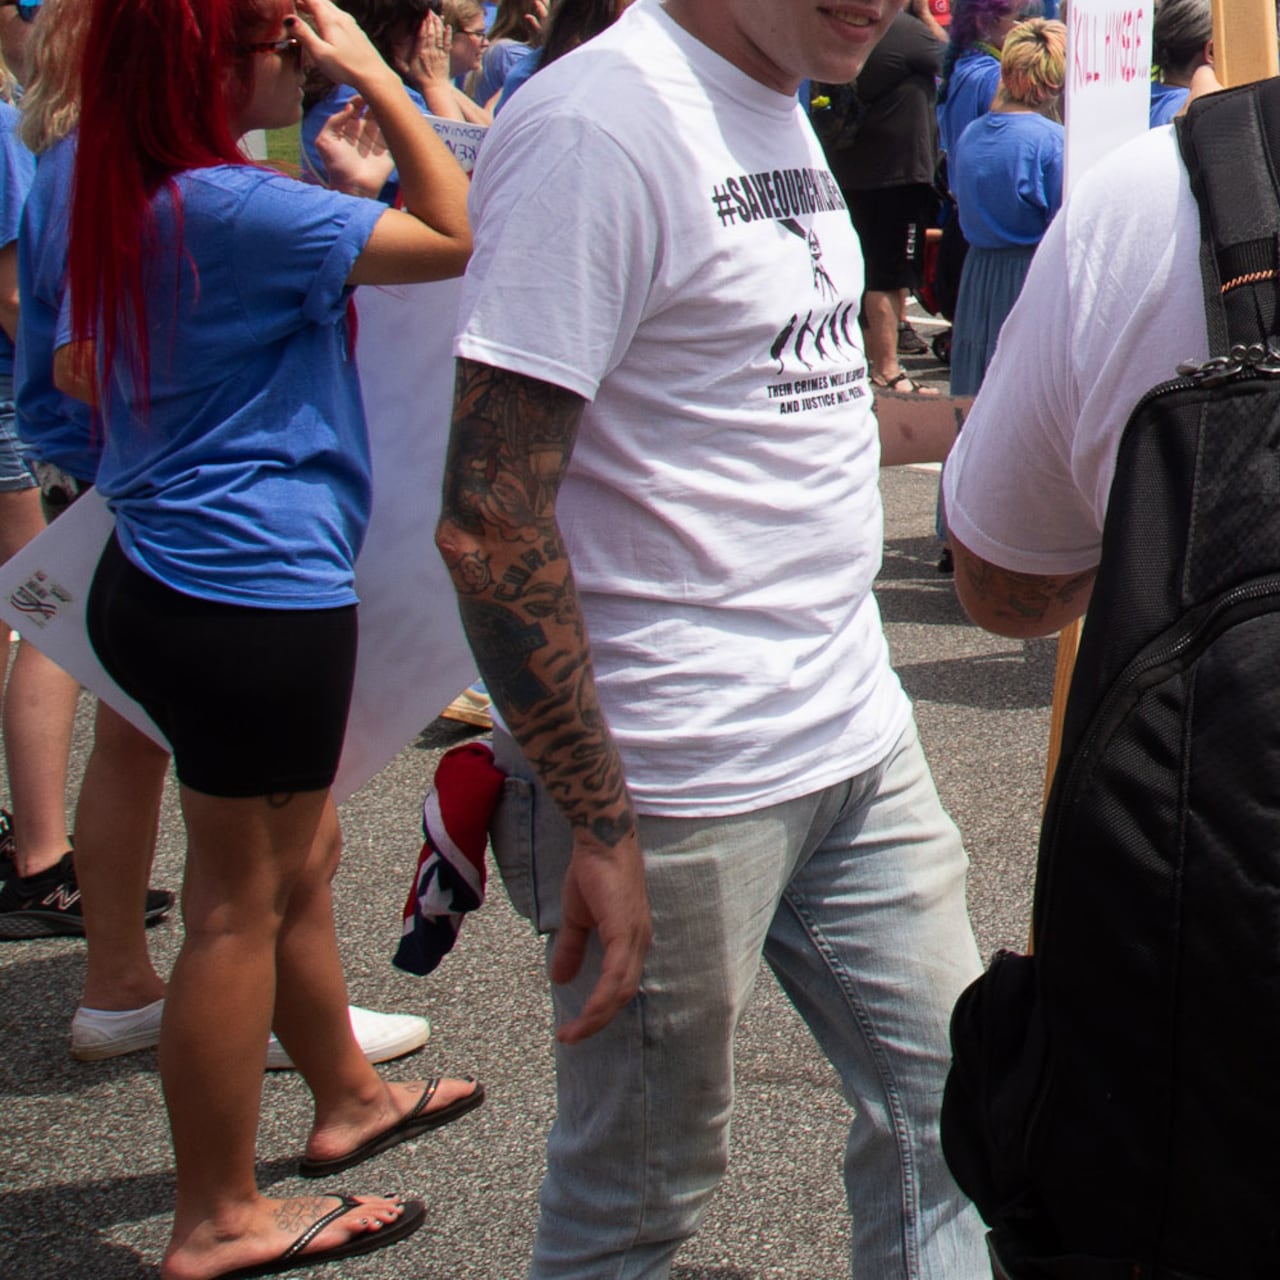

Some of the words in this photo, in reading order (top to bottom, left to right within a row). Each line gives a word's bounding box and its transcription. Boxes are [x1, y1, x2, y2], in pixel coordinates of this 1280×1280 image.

[767, 382, 793, 399] THEIR
[794, 375, 829, 395] CRIMES
[780, 400, 800, 415] AND
[801, 392, 836, 411] JUSTICE
